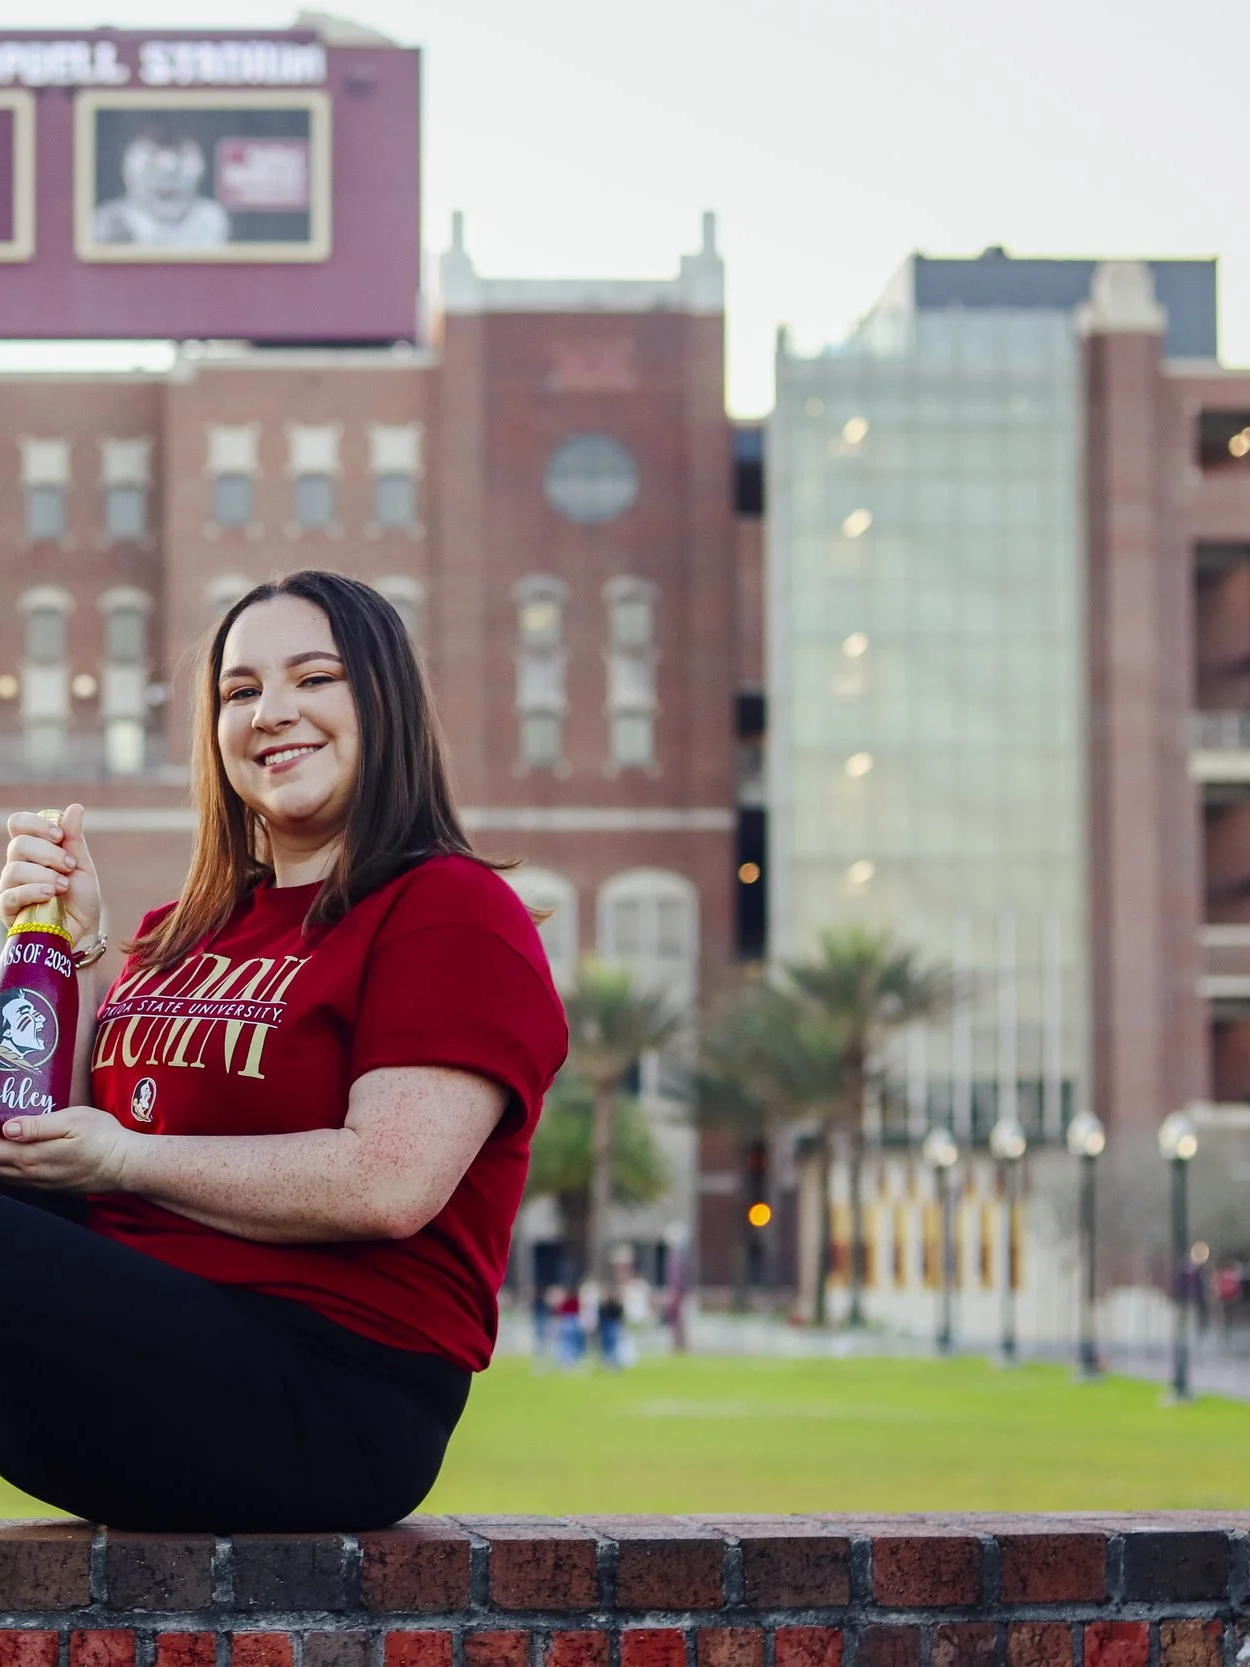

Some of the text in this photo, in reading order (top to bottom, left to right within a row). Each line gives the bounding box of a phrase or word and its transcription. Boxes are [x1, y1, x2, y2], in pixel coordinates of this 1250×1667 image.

[23, 943, 43, 964] OF
[44, 947, 72, 978] 2023
[137, 999, 185, 1014] STATE
